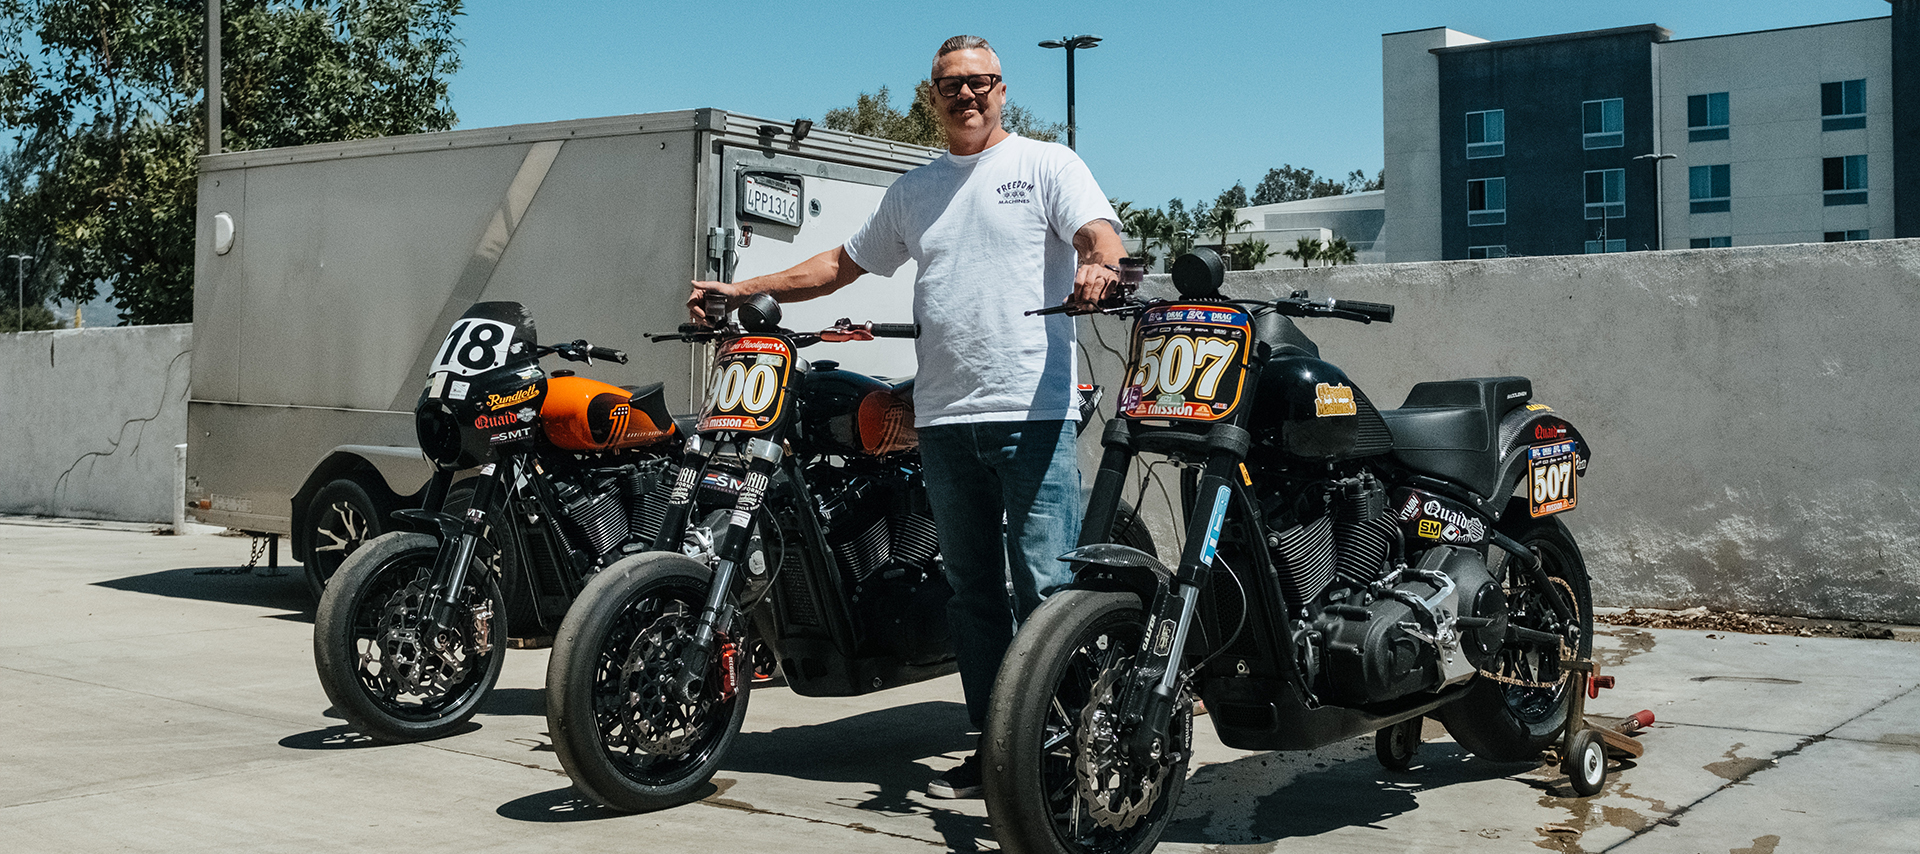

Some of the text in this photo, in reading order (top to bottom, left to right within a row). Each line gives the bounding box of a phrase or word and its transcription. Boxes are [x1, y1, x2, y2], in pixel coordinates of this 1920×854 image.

[996, 180, 1034, 194] FREEDOM
[747, 189, 796, 219] 4PP1316
[440, 320, 504, 370] 18
[742, 340, 773, 351] Hooligan
[1132, 334, 1239, 401] 507
[486, 384, 536, 407] Rundlett
[702, 361, 778, 414] 900
[475, 411, 518, 429] Quaid
[1535, 424, 1557, 439] Quaid
[499, 427, 531, 441] SMT
[1534, 461, 1572, 503] 507
[1424, 500, 1468, 529] Quaid
[1420, 521, 1440, 536] SM
